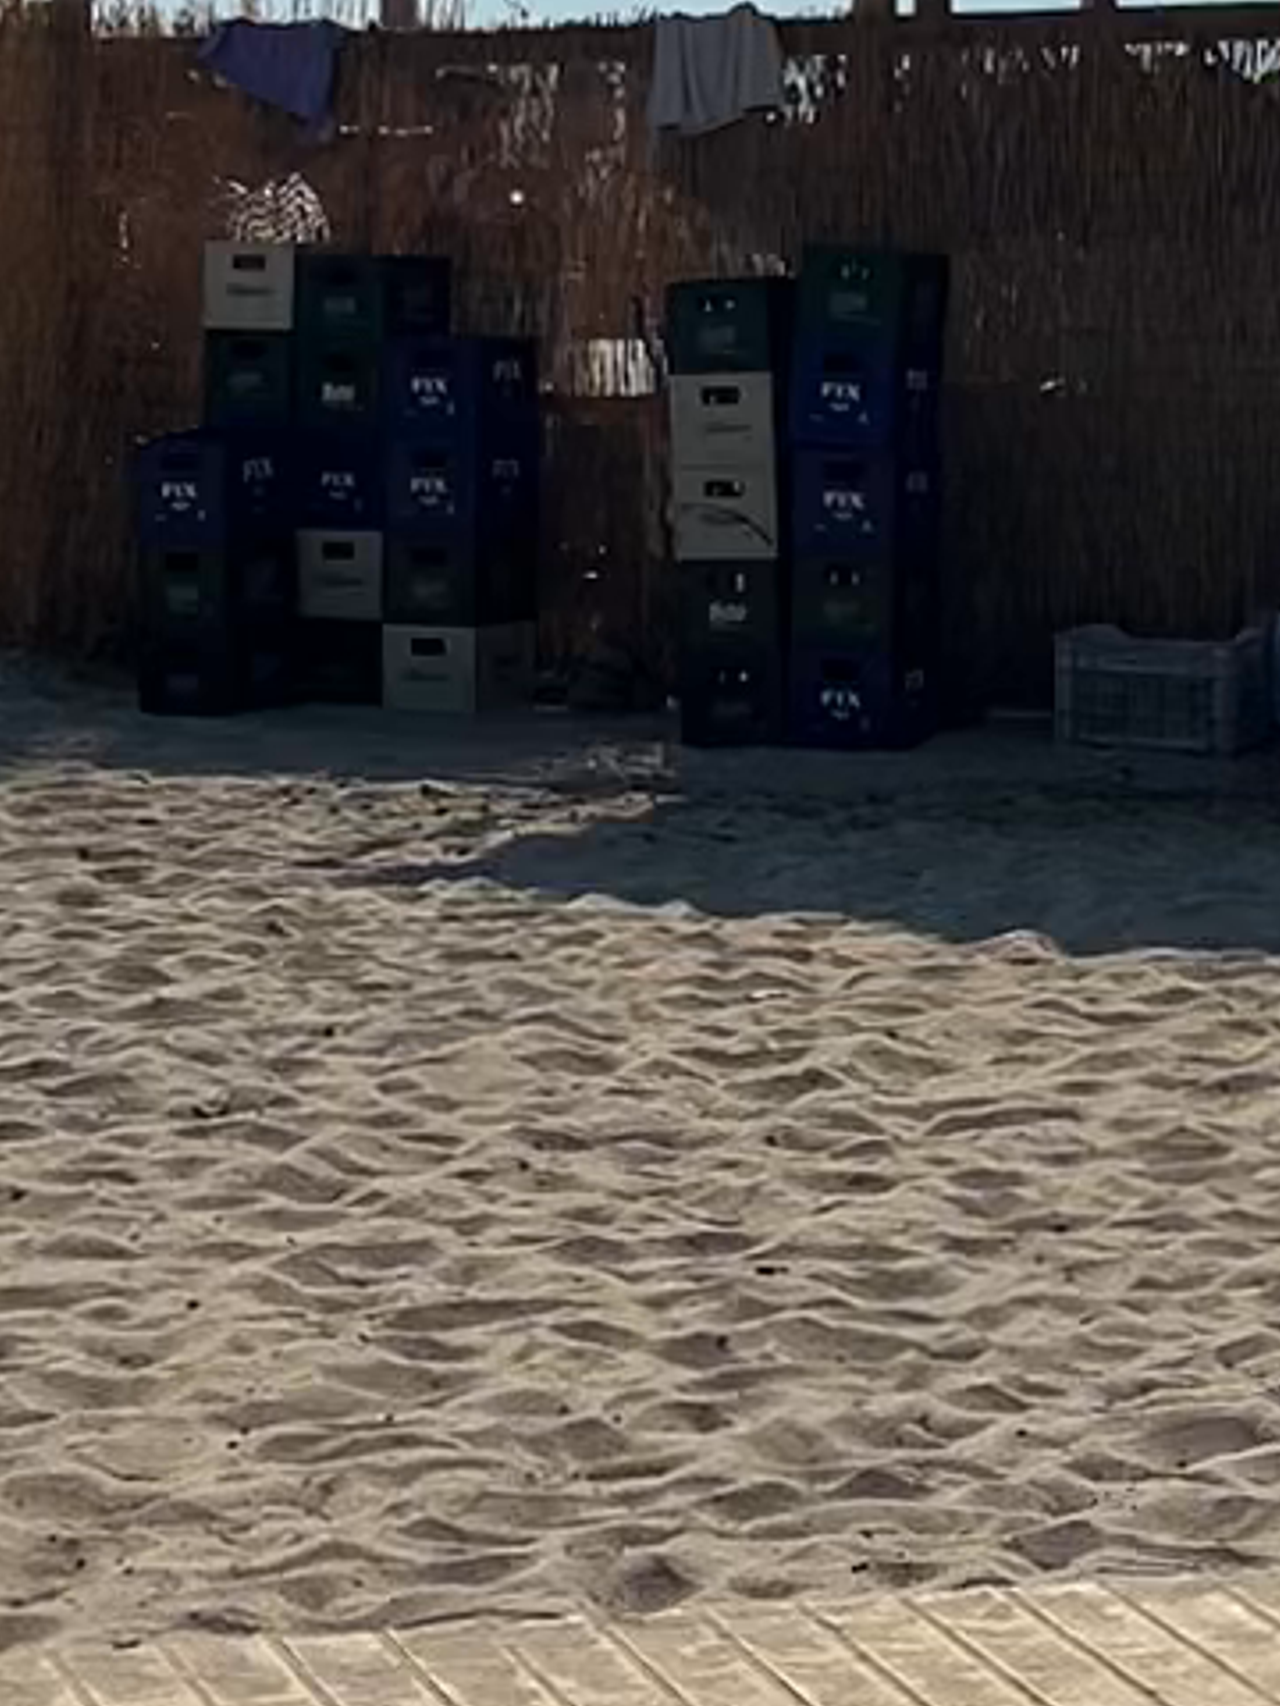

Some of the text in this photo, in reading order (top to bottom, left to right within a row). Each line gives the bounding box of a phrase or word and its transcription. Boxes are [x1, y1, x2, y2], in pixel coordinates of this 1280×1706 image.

[410, 377, 448, 394] FIX
[820, 381, 860, 401] FIX
[320, 471, 355, 487] FIX
[410, 477, 448, 493] FIX
[161, 481, 197, 499] FIX
[824, 490, 865, 508] FIX
[820, 688, 860, 708] FIX
